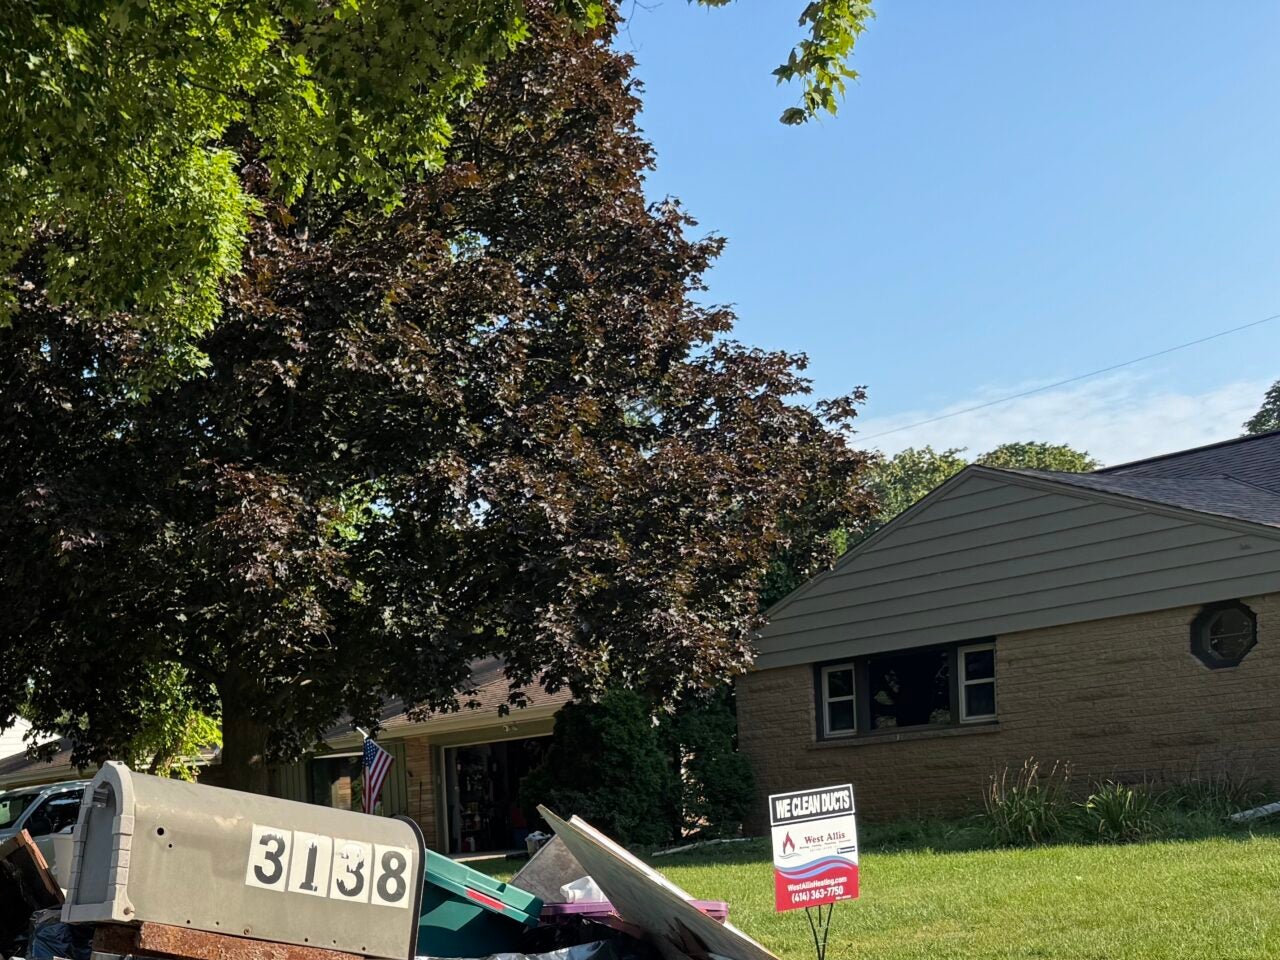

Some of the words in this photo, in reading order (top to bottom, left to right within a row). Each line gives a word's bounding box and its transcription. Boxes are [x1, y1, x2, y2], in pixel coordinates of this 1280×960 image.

[776, 798, 791, 819] WE
[791, 794, 820, 817] CLEAN
[821, 789, 850, 812] DUCTS
[804, 835, 824, 844] West
[826, 831, 846, 841] Allis
[253, 833, 407, 903] 3138
[791, 890, 810, 904] (414)
